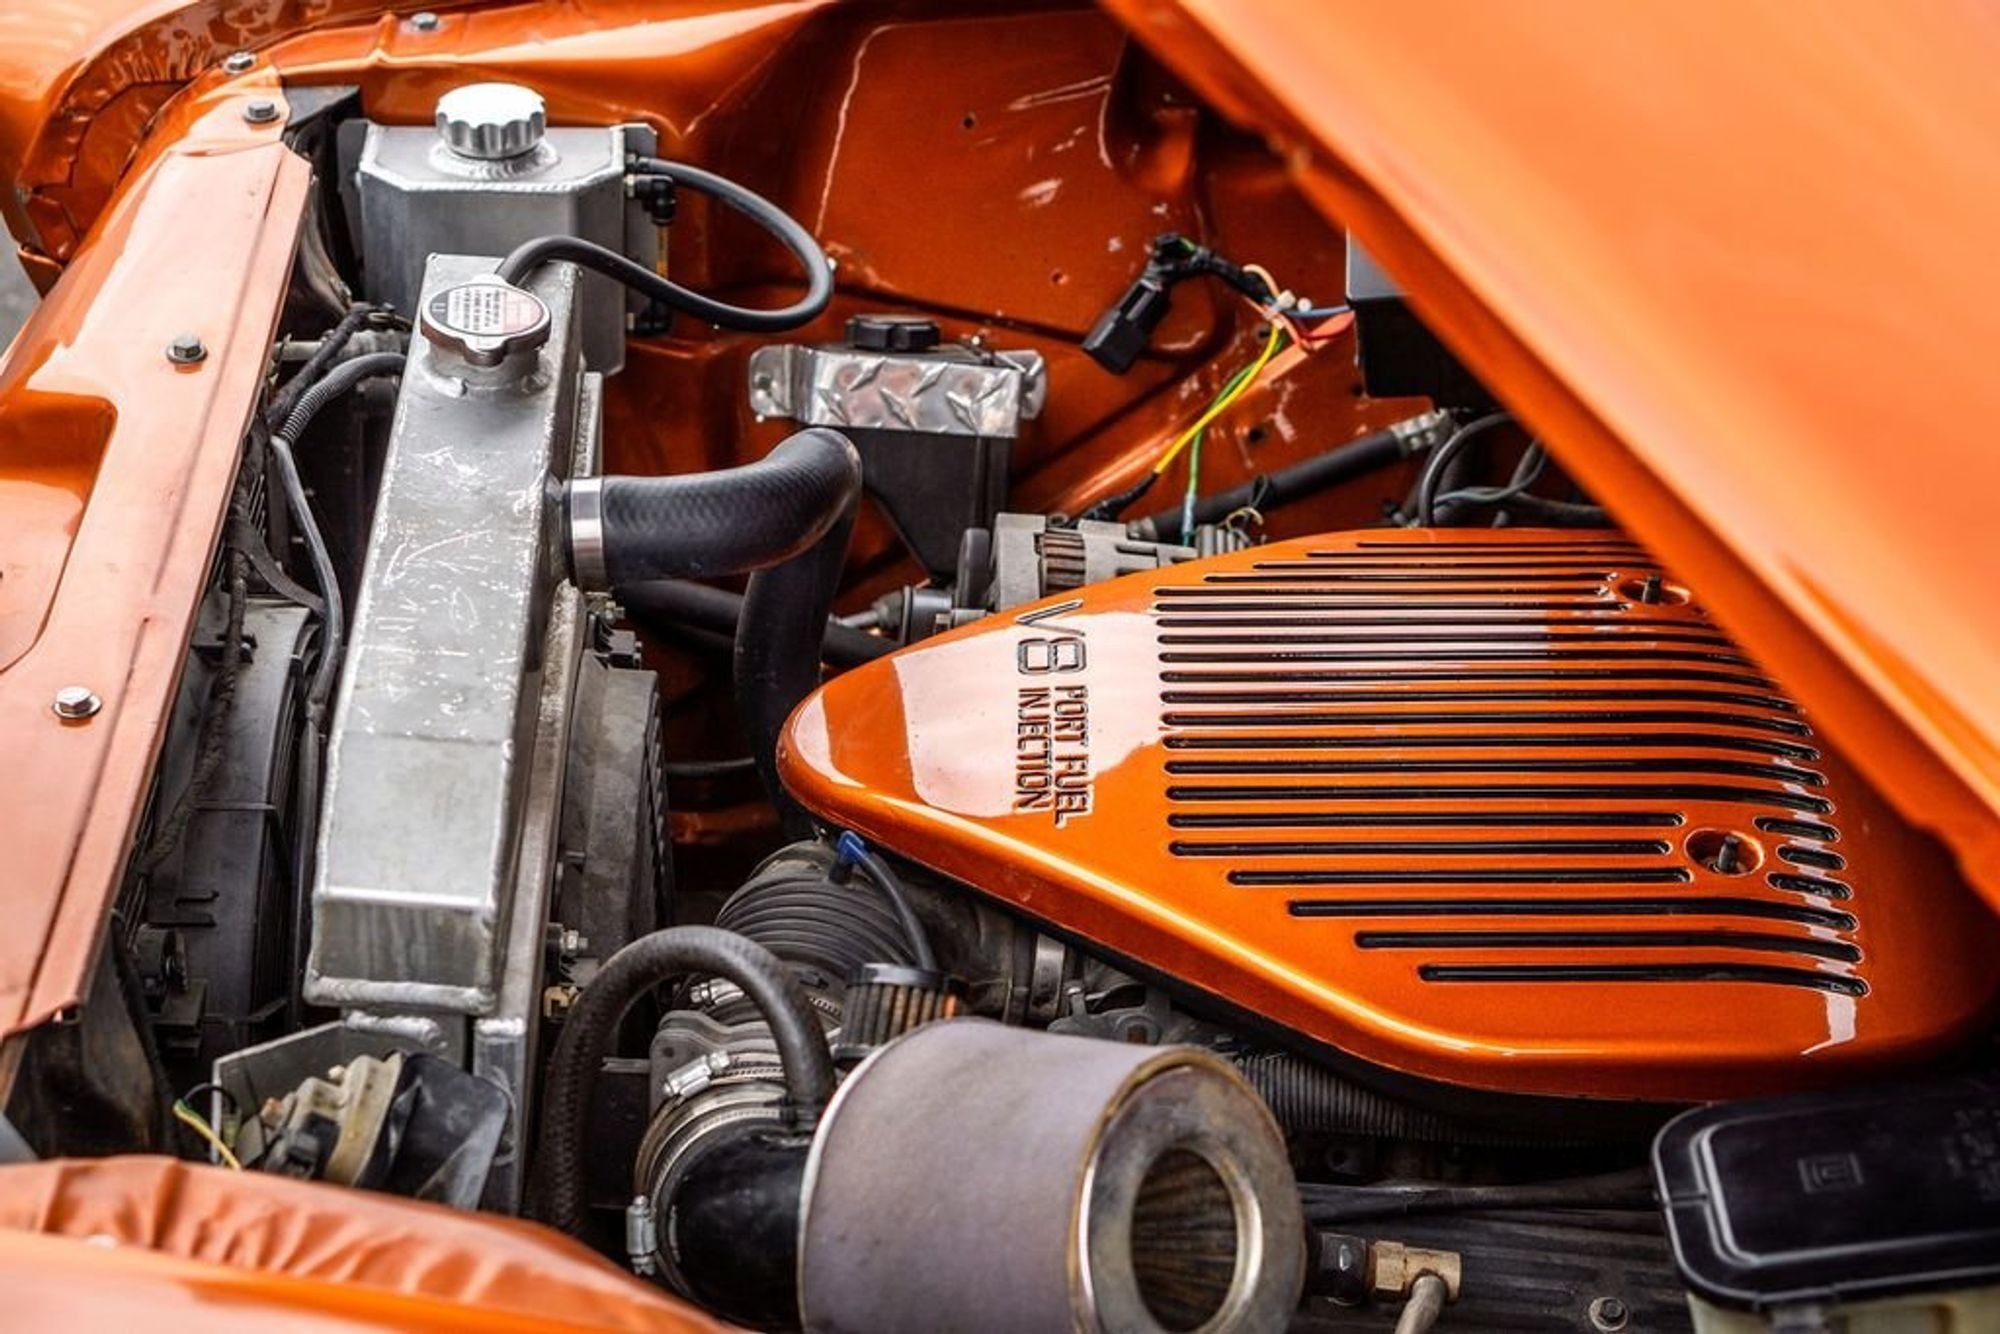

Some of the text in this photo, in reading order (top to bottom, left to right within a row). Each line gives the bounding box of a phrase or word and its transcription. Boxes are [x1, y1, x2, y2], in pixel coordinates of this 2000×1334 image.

[1016, 600, 1088, 675] V8
[1015, 687, 1053, 812] INJECTION
[1054, 686, 1091, 827] PORT FUEL
